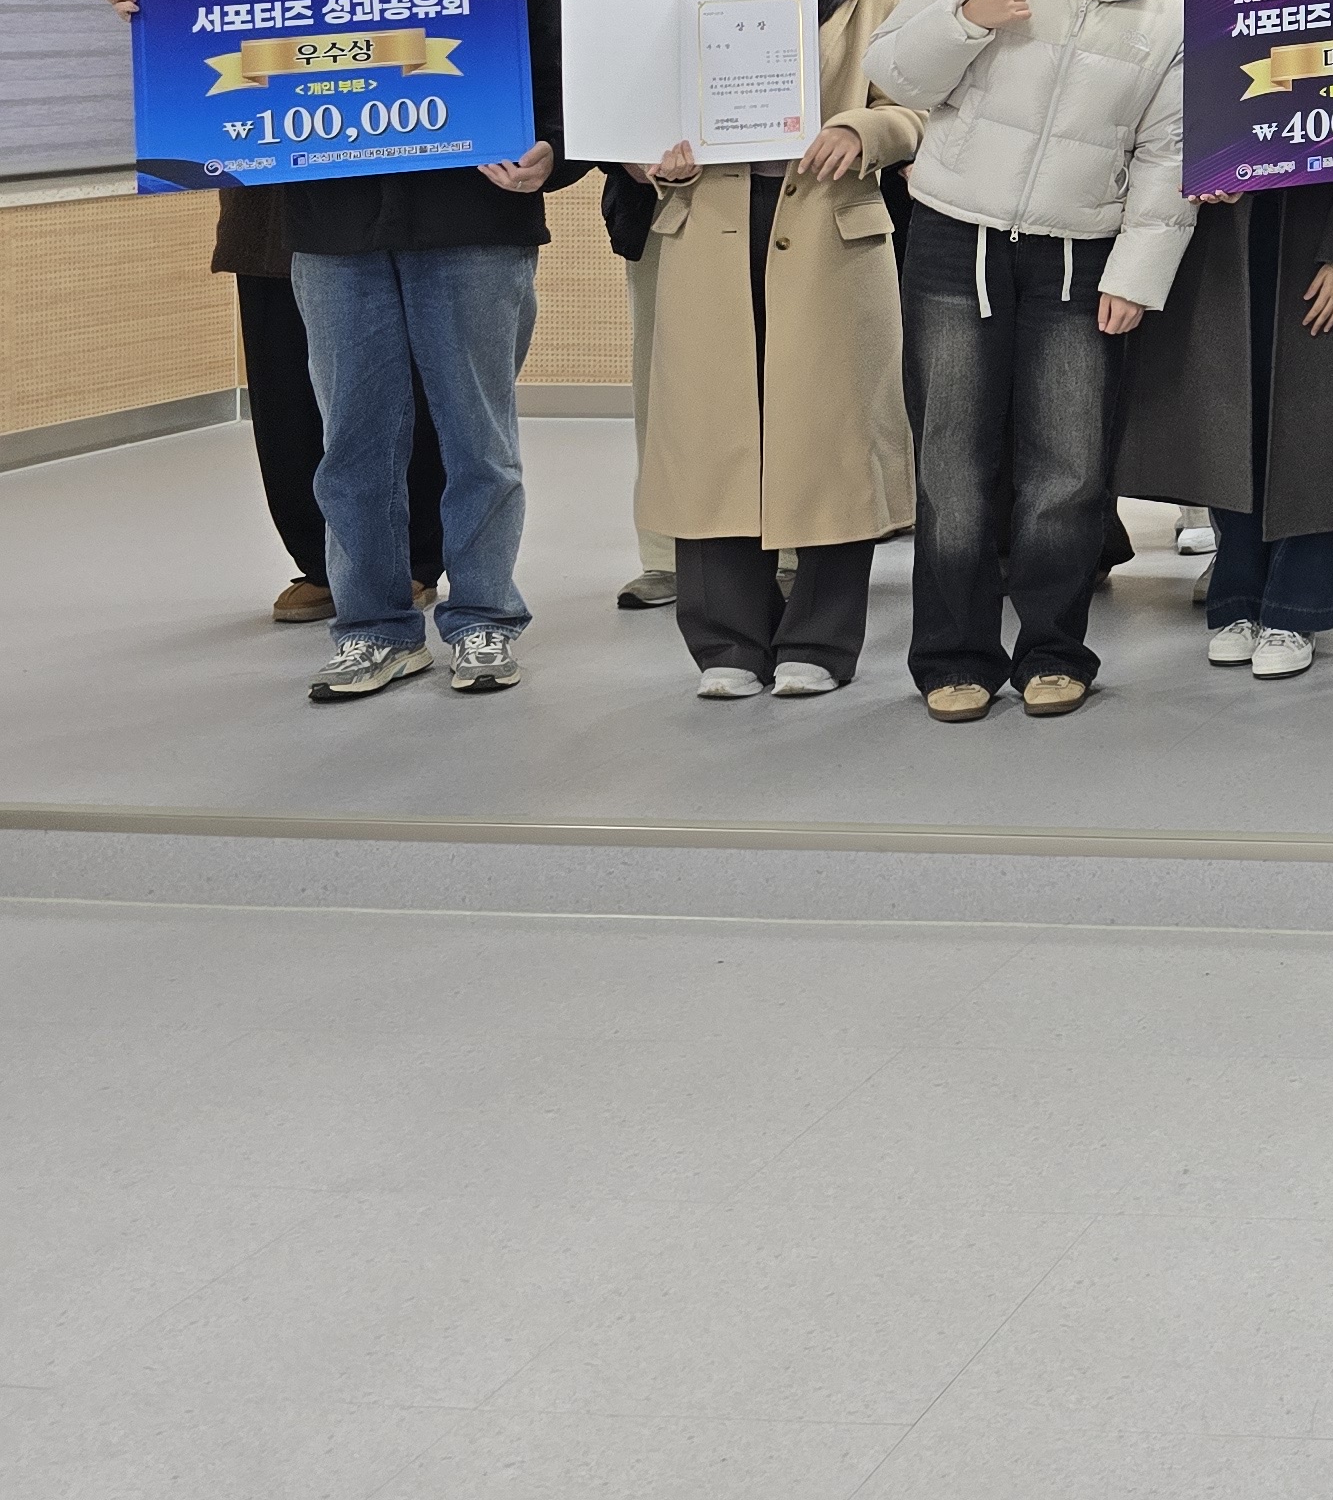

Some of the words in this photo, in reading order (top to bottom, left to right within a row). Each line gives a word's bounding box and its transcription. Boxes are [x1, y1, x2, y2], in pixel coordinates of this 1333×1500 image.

[192, 0, 314, 33] 서포터즈
[1231, 2, 1331, 37] 서포터즈
[295, 39, 374, 66] 우수상
